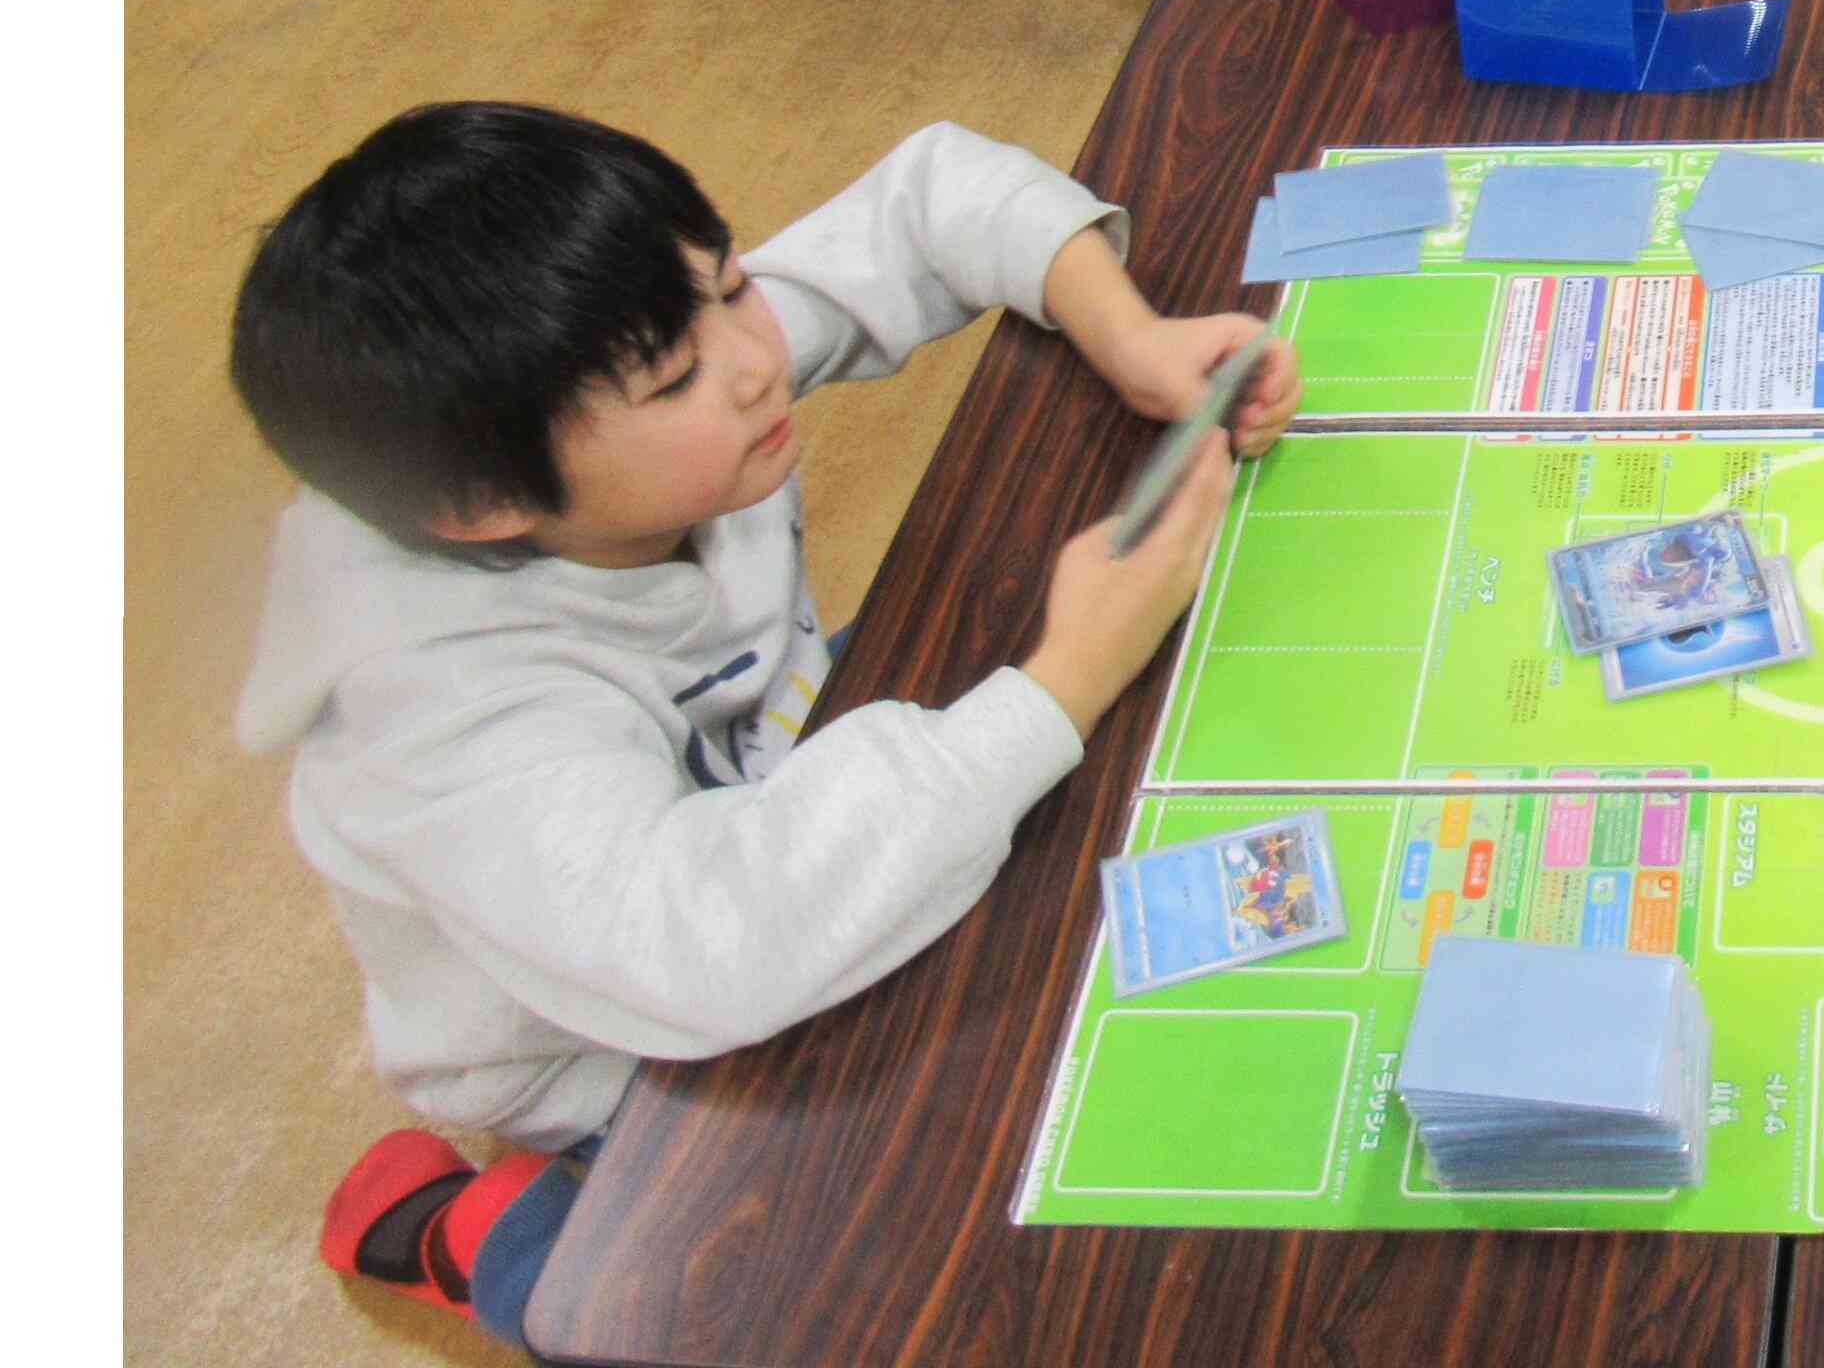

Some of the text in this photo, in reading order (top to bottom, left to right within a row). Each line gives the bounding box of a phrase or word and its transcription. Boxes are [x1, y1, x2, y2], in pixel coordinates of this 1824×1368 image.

[1733, 803, 1759, 888] スタジアム
[1359, 1051, 1400, 1150] トラッシュ
[1763, 1072, 1789, 1136] サイド
